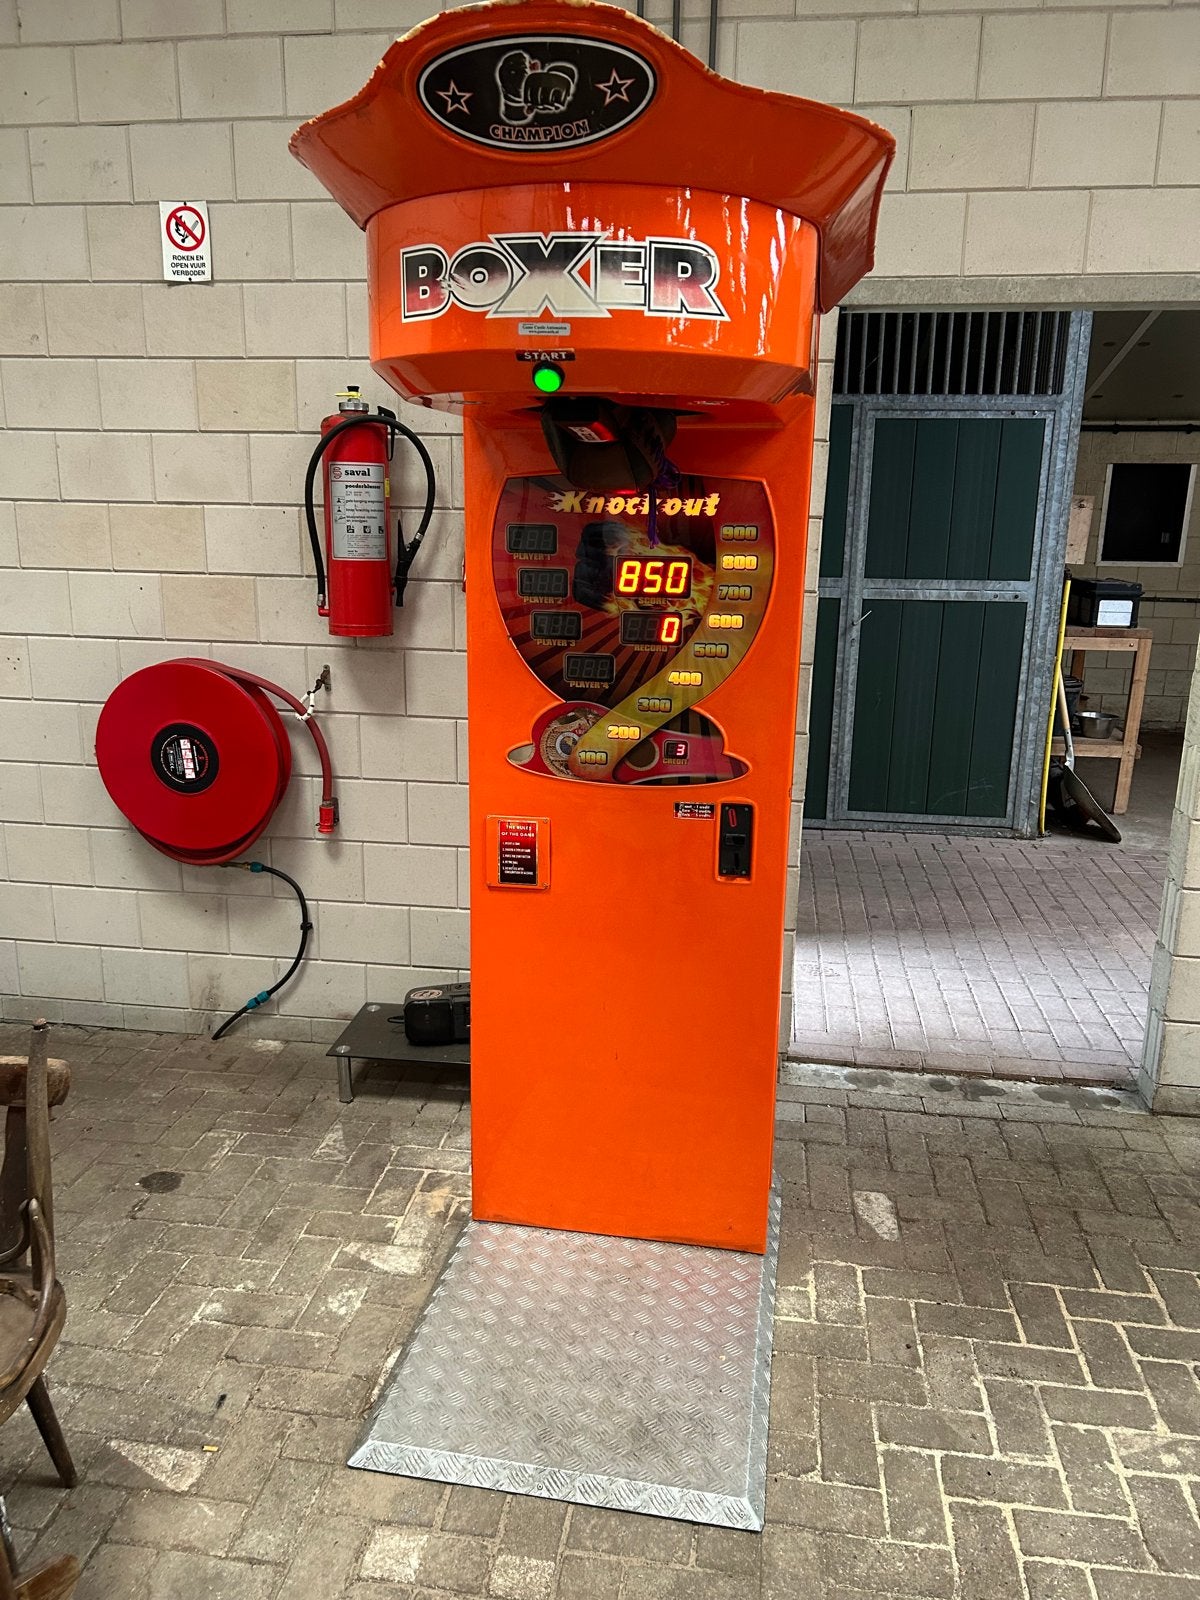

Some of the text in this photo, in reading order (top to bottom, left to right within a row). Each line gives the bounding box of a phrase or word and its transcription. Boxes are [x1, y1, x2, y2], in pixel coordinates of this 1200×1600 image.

[489, 119, 591, 142] CHAMPION
[400, 231, 732, 324] BOXER
[524, 352, 567, 361] START
[344, 468, 371, 476] saval
[721, 524, 758, 541] 900
[513, 553, 544, 561] PLAYER
[721, 554, 758, 570] 800
[618, 561, 689, 593] 850
[523, 596, 554, 604] PLAYER
[718, 585, 752, 601] 700
[638, 597, 668, 605] SCORE
[708, 613, 744, 629] 600
[661, 617, 680, 643] 0
[536, 638, 576, 647] PLAYER 3
[634, 644, 668, 652] RECORD
[694, 643, 729, 658] 500
[569, 681, 600, 689] PLAYER
[668, 670, 703, 686] 400
[637, 697, 672, 713] 300
[606, 724, 641, 740] 200
[676, 743, 686, 756] 3
[578, 750, 608, 765] 100
[662, 757, 688, 766] CREDIT
